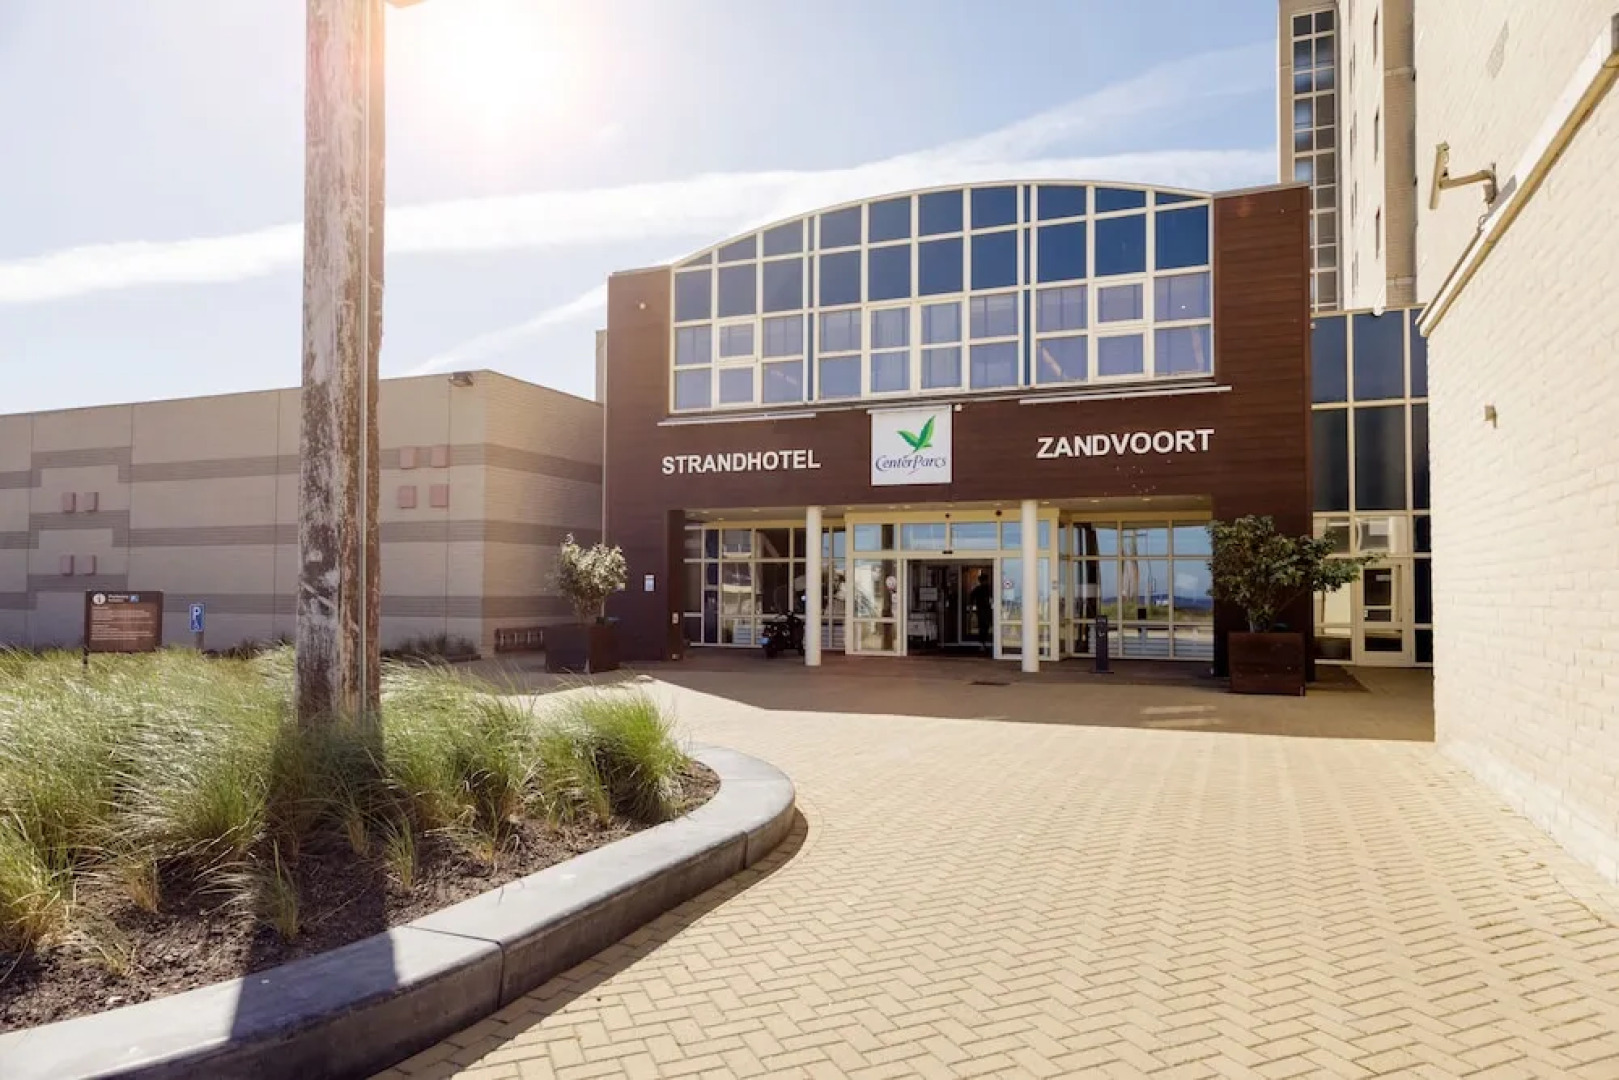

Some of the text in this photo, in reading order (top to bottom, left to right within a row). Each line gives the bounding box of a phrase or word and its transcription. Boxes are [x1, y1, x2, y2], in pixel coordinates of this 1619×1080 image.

[1036, 428, 1215, 459] ZANDVOORT
[661, 449, 822, 475] STRANDHOTEL
[193, 606, 202, 621] P
